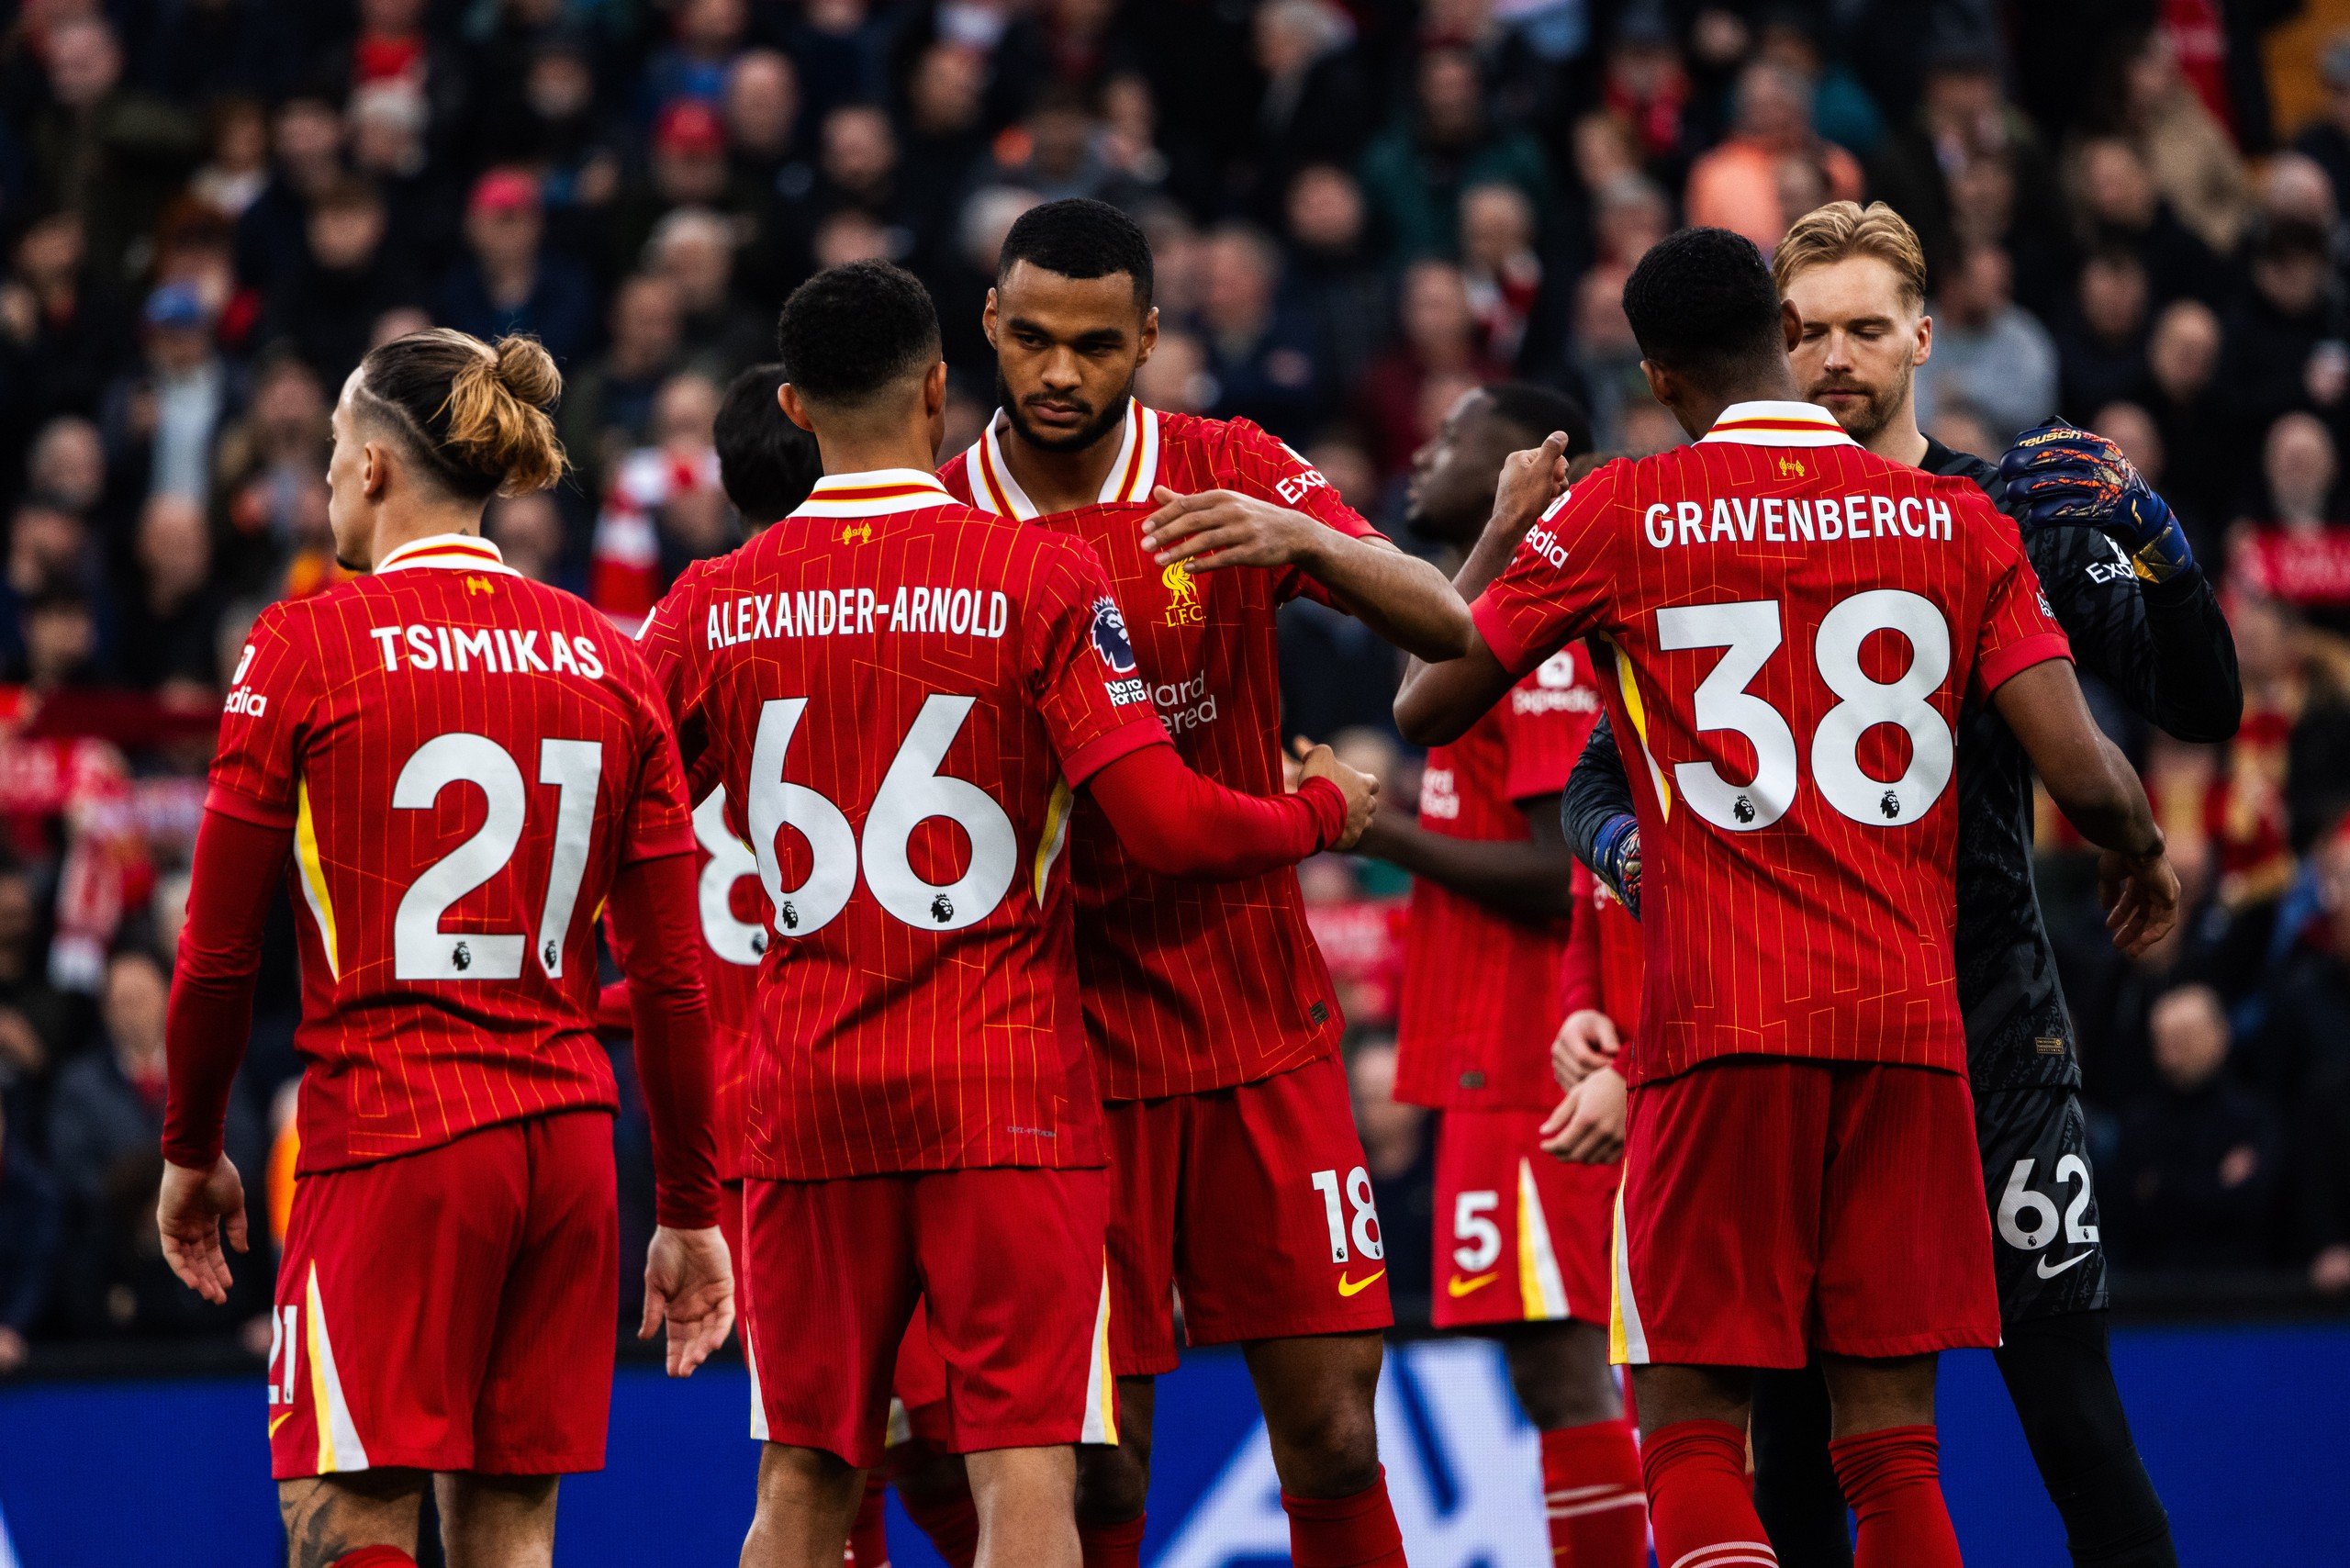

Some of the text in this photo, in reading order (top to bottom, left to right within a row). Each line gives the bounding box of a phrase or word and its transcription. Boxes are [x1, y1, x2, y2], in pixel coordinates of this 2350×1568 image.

[2019, 430, 2082, 447] reusch
[1275, 469, 1330, 505] Exp
[1644, 495, 1953, 549] GRAVENBERCH
[2085, 562, 2140, 584] Exp
[707, 586, 1008, 651] ALEXANDER-ARNOLD
[1165, 605, 1206, 628] L.F.C.
[370, 623, 606, 679] TSIMIKAS
[1104, 678, 1142, 695] No ro
[1110, 692, 1129, 707] for
[1655, 588, 1953, 833] 38
[744, 693, 1017, 937] 66
[392, 733, 603, 980] 21
[1311, 1166, 1383, 1264] 18
[1998, 1153, 2100, 1250] 62
[1453, 1191, 1502, 1272] 5
